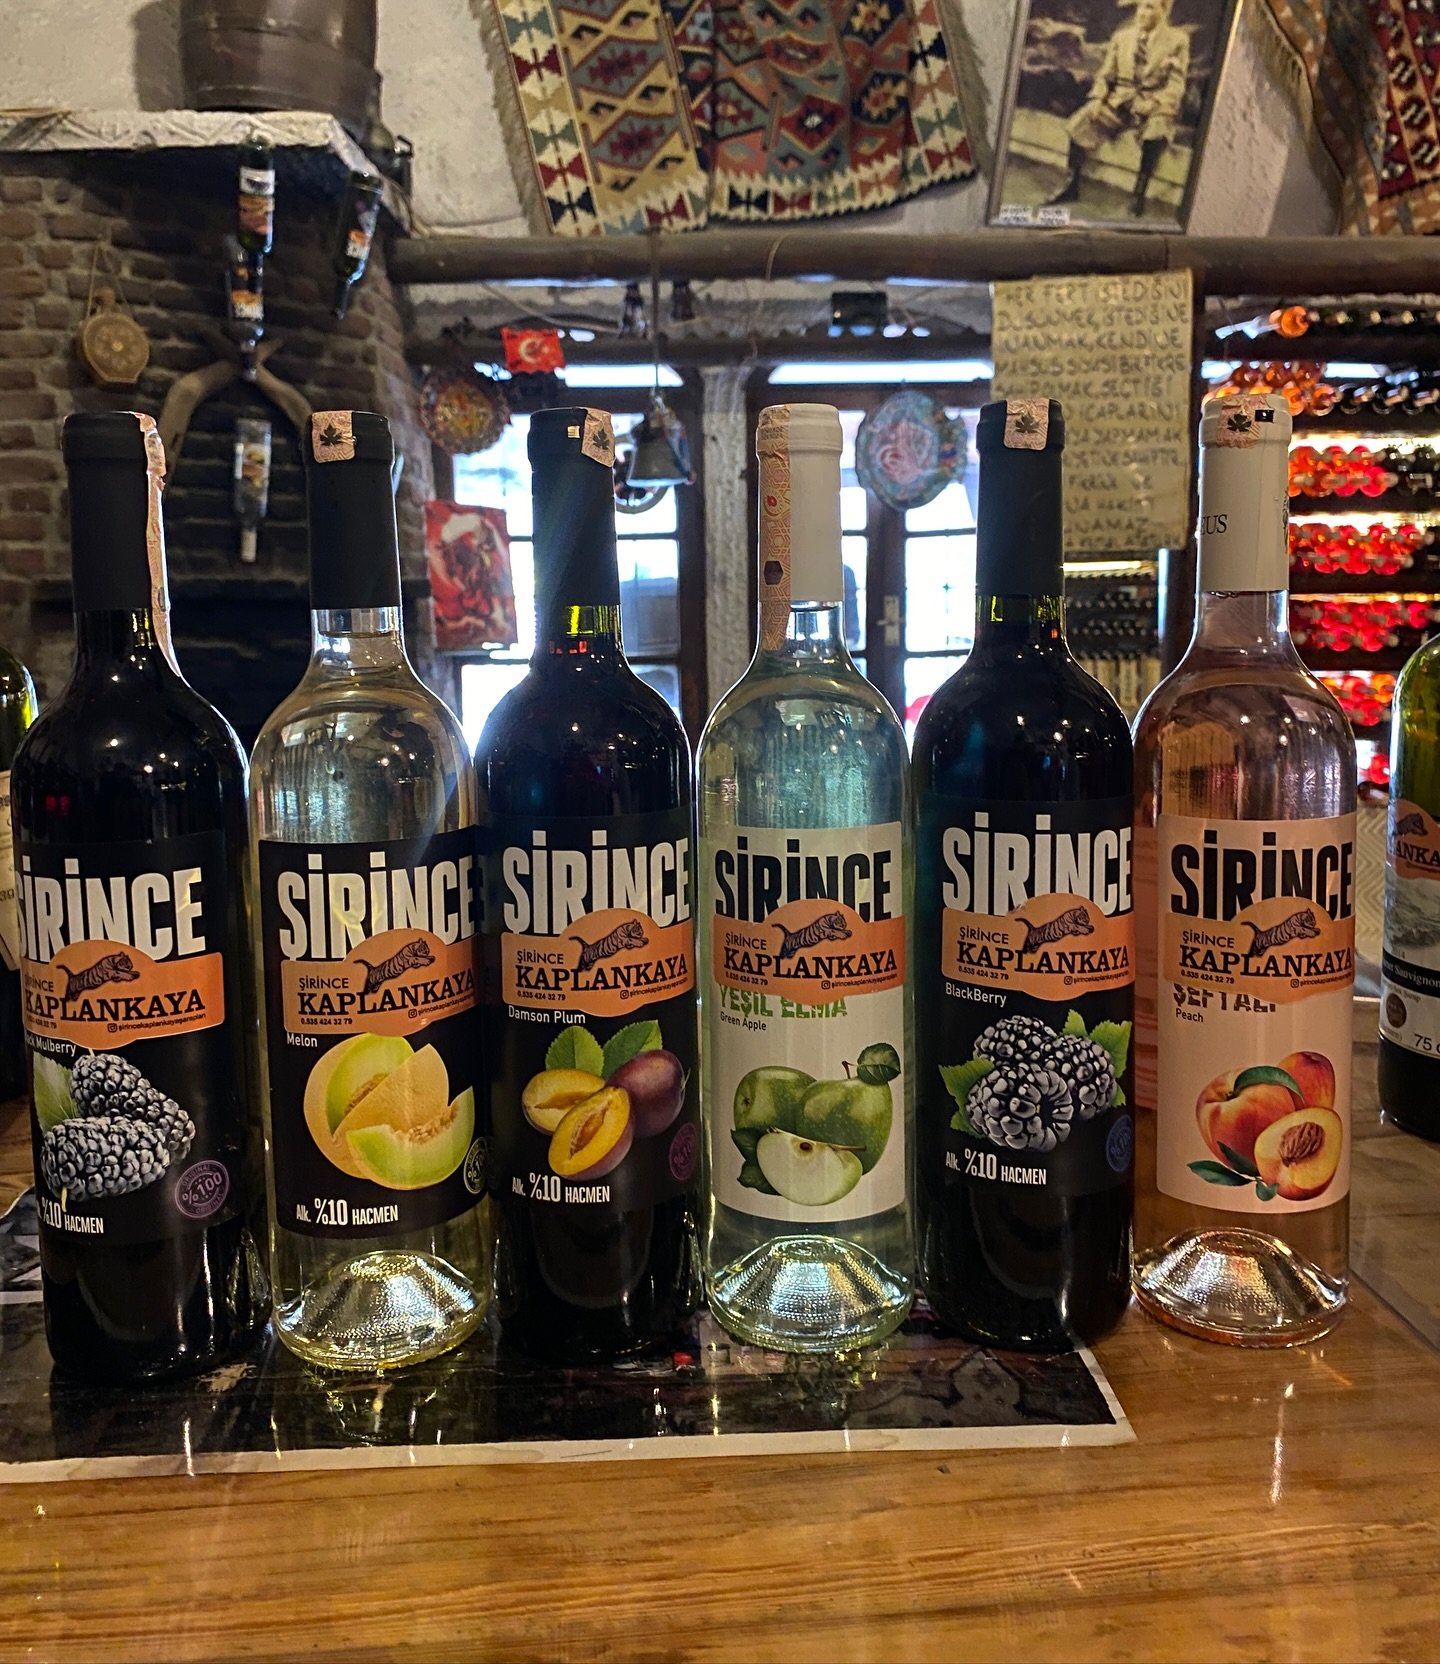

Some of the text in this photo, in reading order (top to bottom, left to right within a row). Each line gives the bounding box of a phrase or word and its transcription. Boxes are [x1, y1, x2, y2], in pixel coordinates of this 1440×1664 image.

[725, 932, 767, 950] ŞİRİNCE
[959, 925, 1009, 945] ŞİRİNCE
[1182, 929, 1235, 948] ŞİRİNCE
[517, 949, 564, 965] ŞİRİNCE
[723, 947, 897, 979] KAPLANKAYA
[956, 940, 1130, 974] KAPLANKAYA
[1179, 945, 1352, 977] KAPLANKAYA
[299, 976, 349, 991] ŞİRİNCE
[515, 953, 688, 992] KAPLANKAYA
[297, 968, 475, 1015] KAPLANKAYA
[945, 982, 1007, 1008] BlackBerry
[25, 988, 206, 1022] KAPLANKAYA
[508, 1005, 586, 1024] Damson Plum
[1175, 1008, 1204, 1023] Peach
[720, 1011, 767, 1031] Green Apple
[36, 1036, 76, 1057] Mulberry
[286, 1033, 318, 1048] Melon
[1414, 1033, 1432, 1051] 75
[945, 1148, 1047, 1185] Alk. %10 HACMEN
[182, 1172, 223, 1204] %100
[511, 1172, 610, 1203] Alk. %10 HACMEN
[42, 1196, 62, 1228] %10
[64, 1214, 104, 1234] HACMEN
[296, 1198, 399, 1226] Alk. %10 HACMEN
